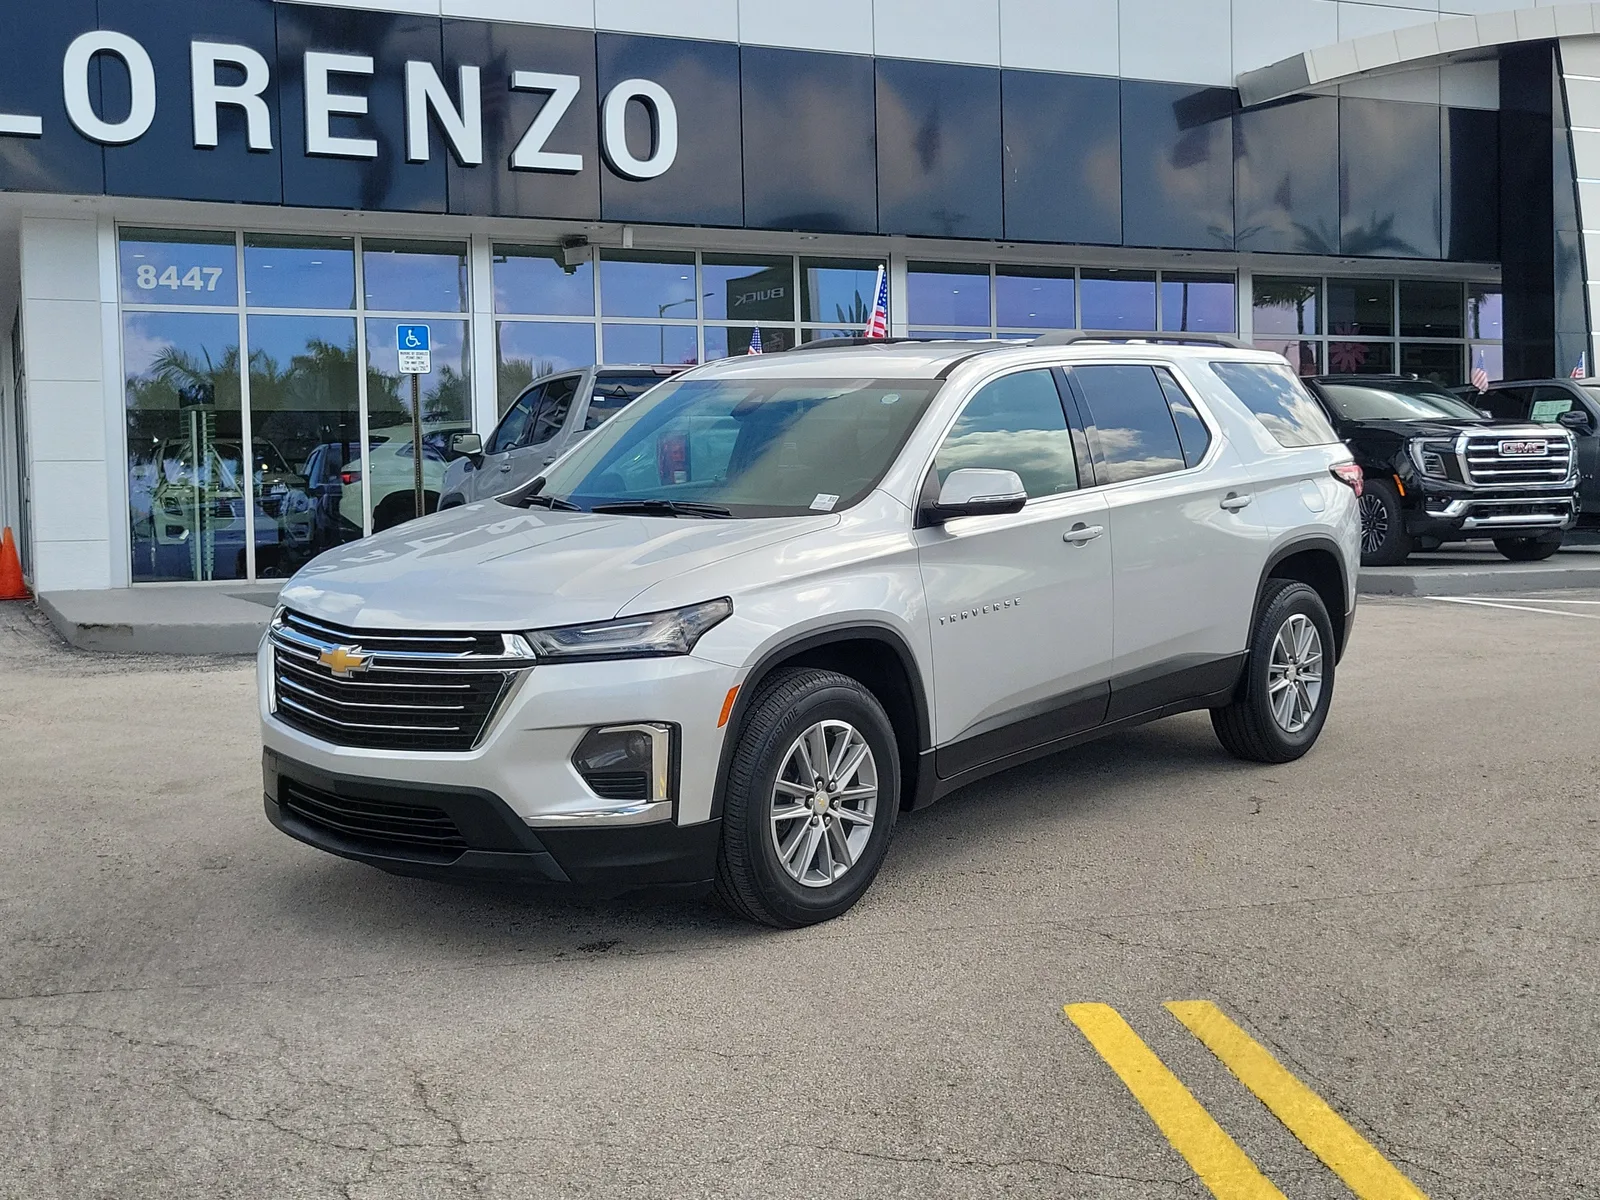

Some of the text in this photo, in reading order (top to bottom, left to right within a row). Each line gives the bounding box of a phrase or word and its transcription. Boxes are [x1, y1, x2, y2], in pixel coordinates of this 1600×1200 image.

[137, 265, 222, 291] 8447
[1503, 442, 1545, 454] GMC
[939, 597, 1021, 625] TRAVERSE
[757, 705, 799, 776] IDGESTONE
